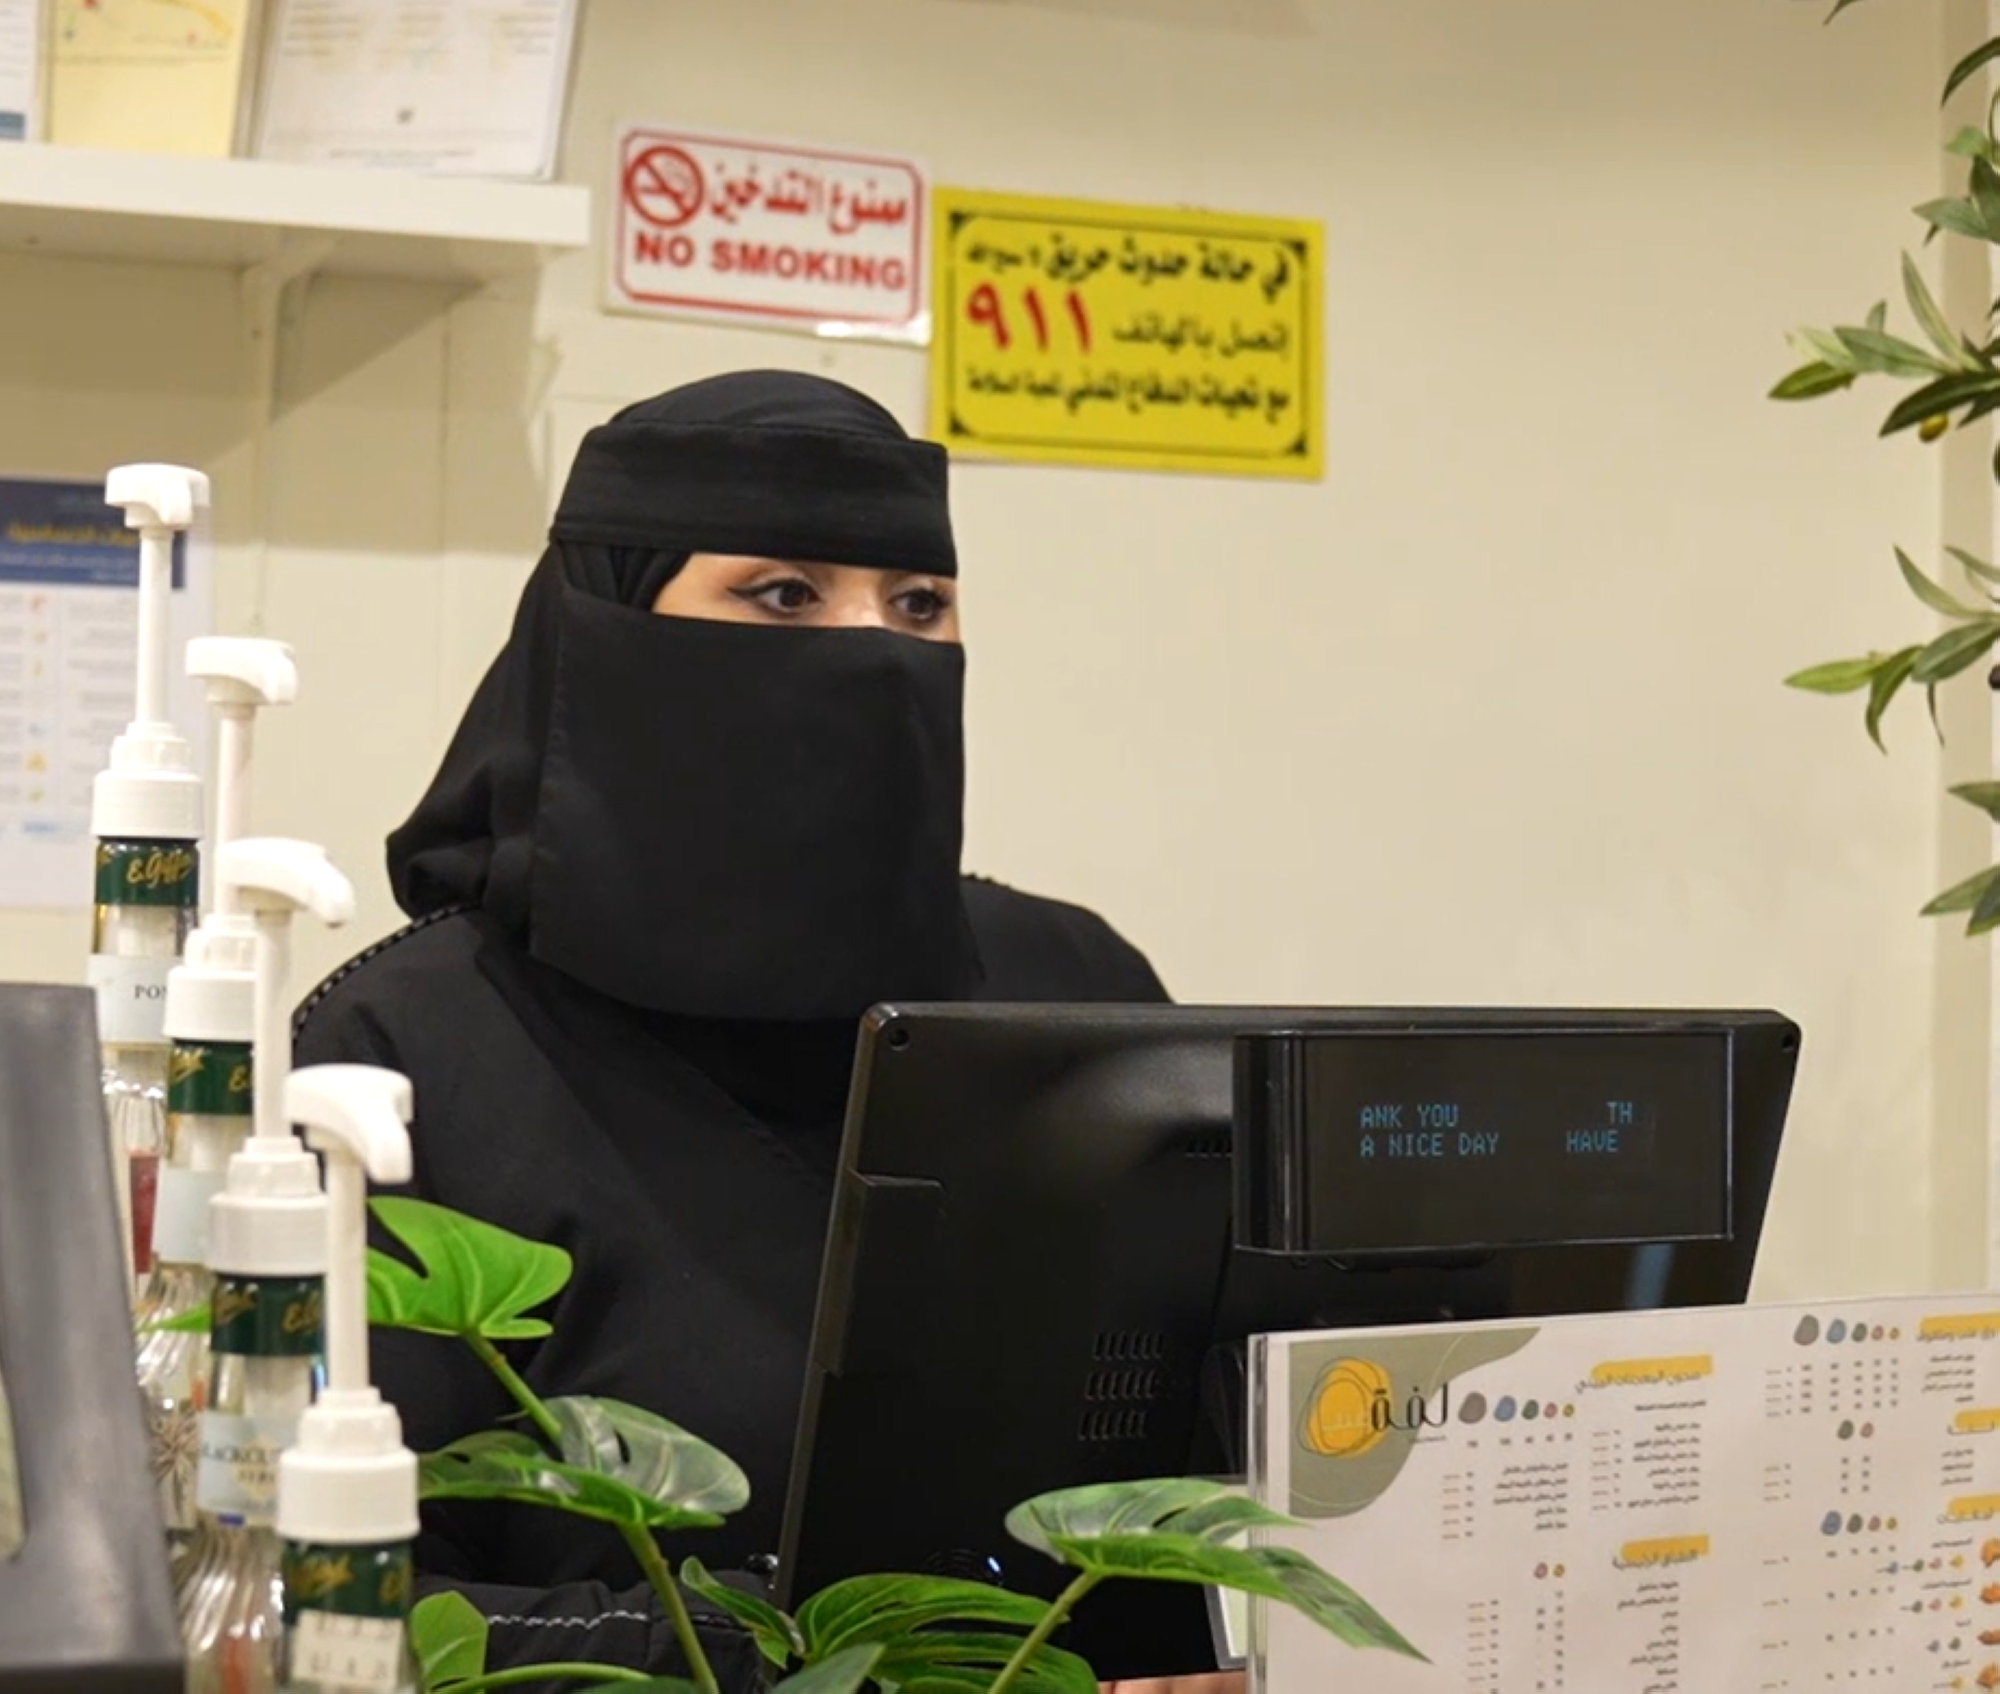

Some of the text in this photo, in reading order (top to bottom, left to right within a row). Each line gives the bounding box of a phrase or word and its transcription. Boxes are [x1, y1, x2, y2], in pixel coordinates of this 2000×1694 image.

[711, 161, 906, 235] ممنوع التدخين
[634, 231, 906, 290] NO SMOKING
[1046, 233, 1110, 284] حريق
[1117, 236, 1189, 286] حدوث
[1198, 242, 1254, 282] حالة
[1261, 250, 1290, 304] في
[966, 282, 1091, 355] ٩١١
[1112, 312, 1215, 358] بالهاتف
[1127, 374, 1192, 414] الدفاع
[1199, 374, 1260, 418] تحيات
[1264, 389, 1290, 424] مع
[1360, 1101, 1633, 1129] ANK YOU TH
[1360, 1129, 1619, 1157] A NICE DAY HAVE
[1371, 1381, 1449, 1433] لفة
